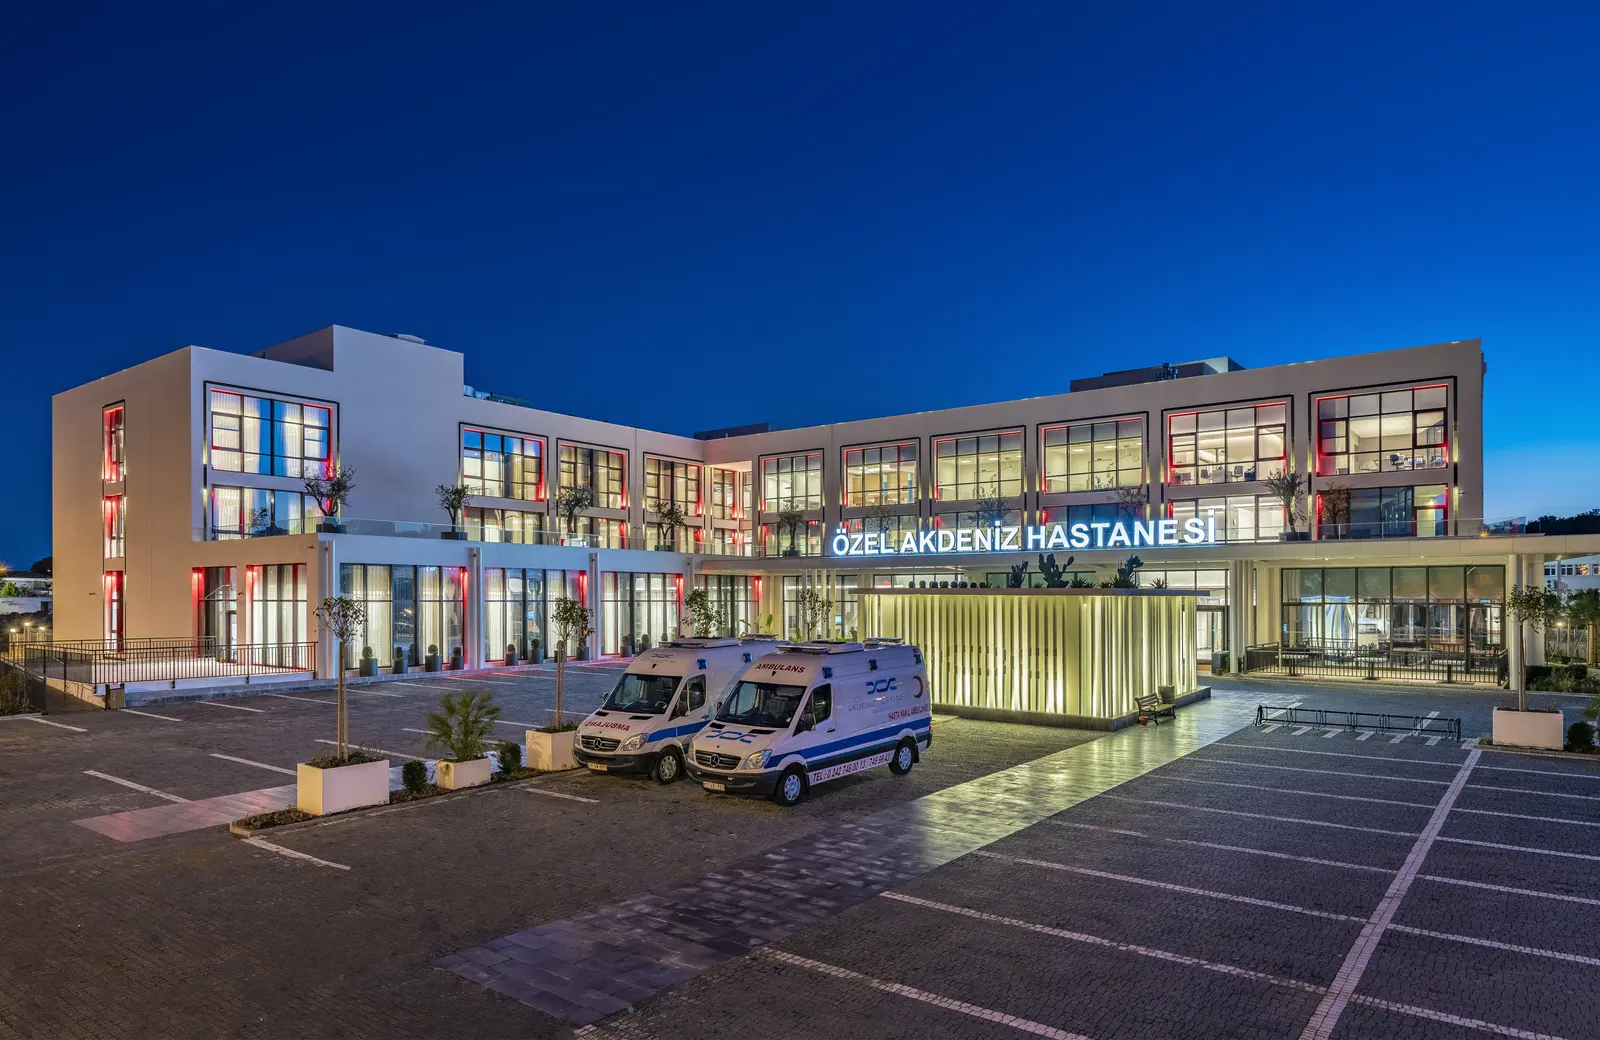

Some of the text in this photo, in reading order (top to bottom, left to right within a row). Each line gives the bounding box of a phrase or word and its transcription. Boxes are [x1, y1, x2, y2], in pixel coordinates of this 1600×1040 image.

[833, 509, 1215, 555] ÖZEL AKDENİZ HASTANESİ
[755, 663, 805, 673] AMBULANS
[832, 766, 842, 777] 242
